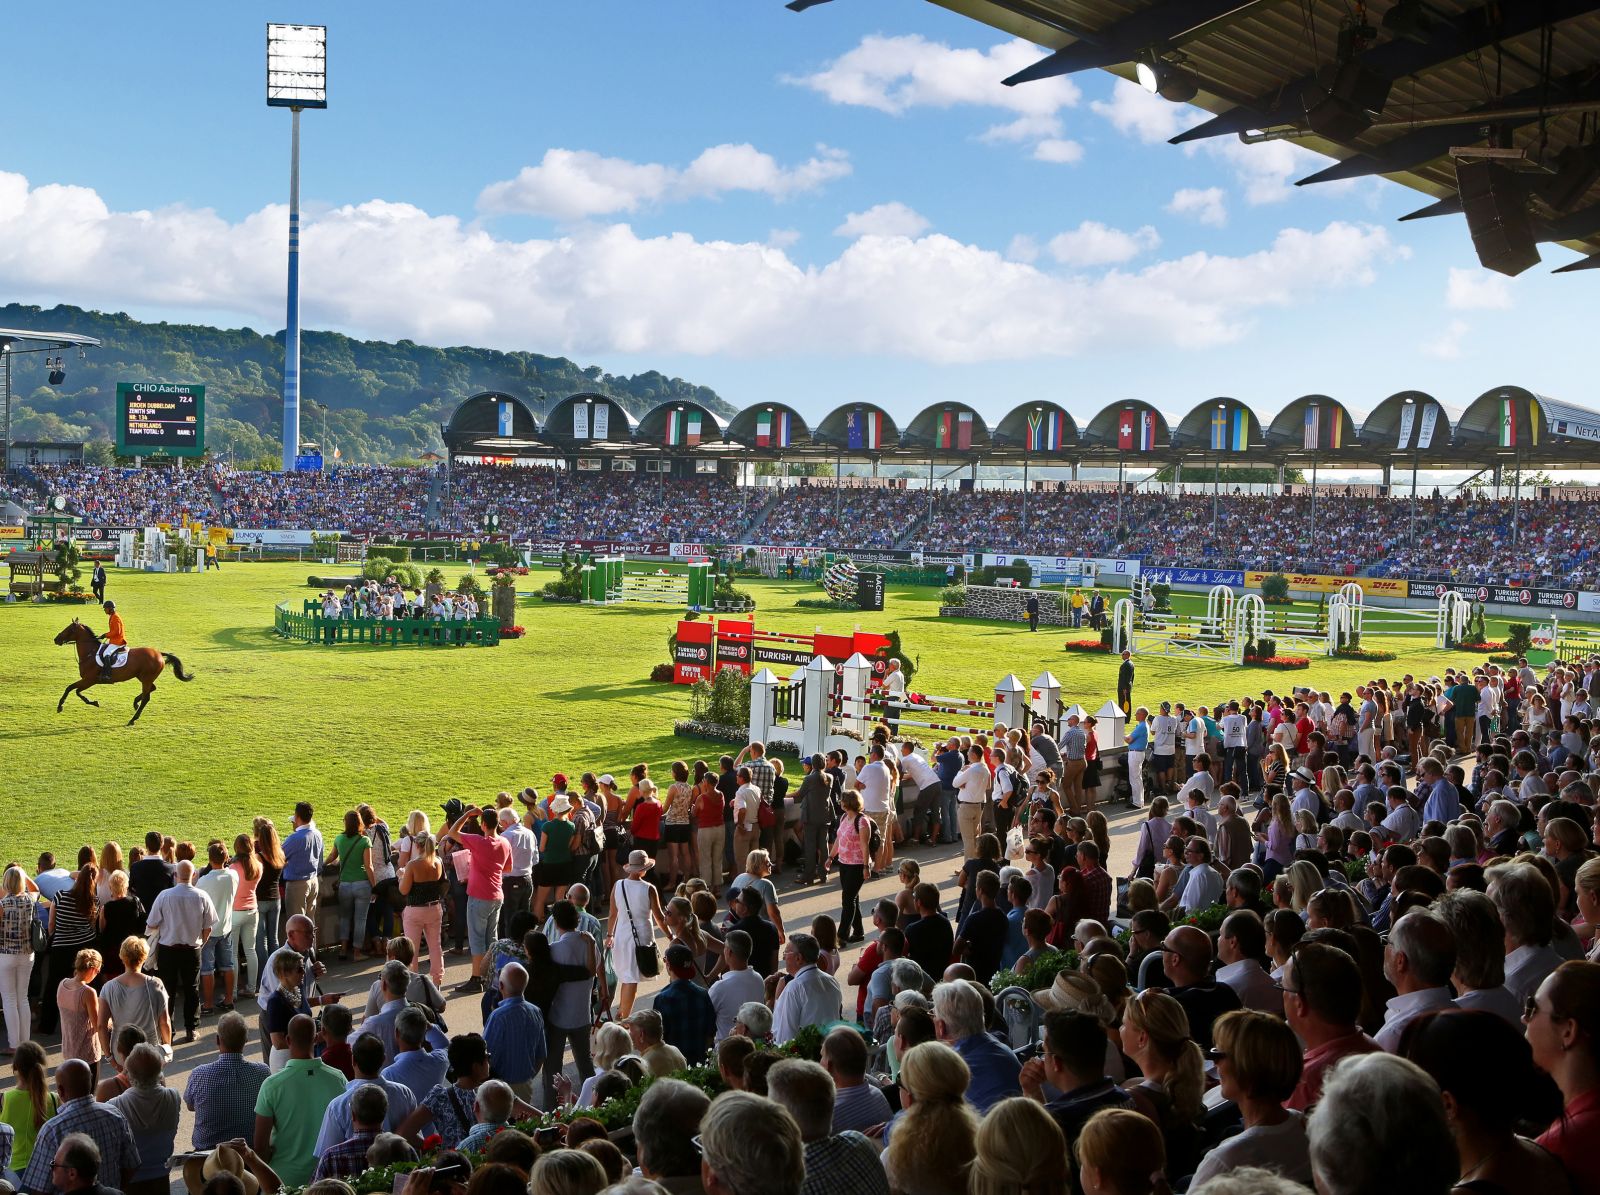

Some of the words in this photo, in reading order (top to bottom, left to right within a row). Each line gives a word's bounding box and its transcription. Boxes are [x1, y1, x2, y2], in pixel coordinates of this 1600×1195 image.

[133, 383, 157, 392] CHIO
[158, 384, 190, 394] Aachen
[611, 544, 651, 554] LAMBERTZ
[848, 552, 895, 560] Mercedes-Benz
[1177, 570, 1201, 582] Lindt
[1212, 571, 1235, 584] Lindt
[1293, 576, 1318, 585] DHL
[1373, 581, 1398, 590] DHL
[677, 651, 698, 659] AIRLINES
[758, 650, 792, 661] TURKISH
